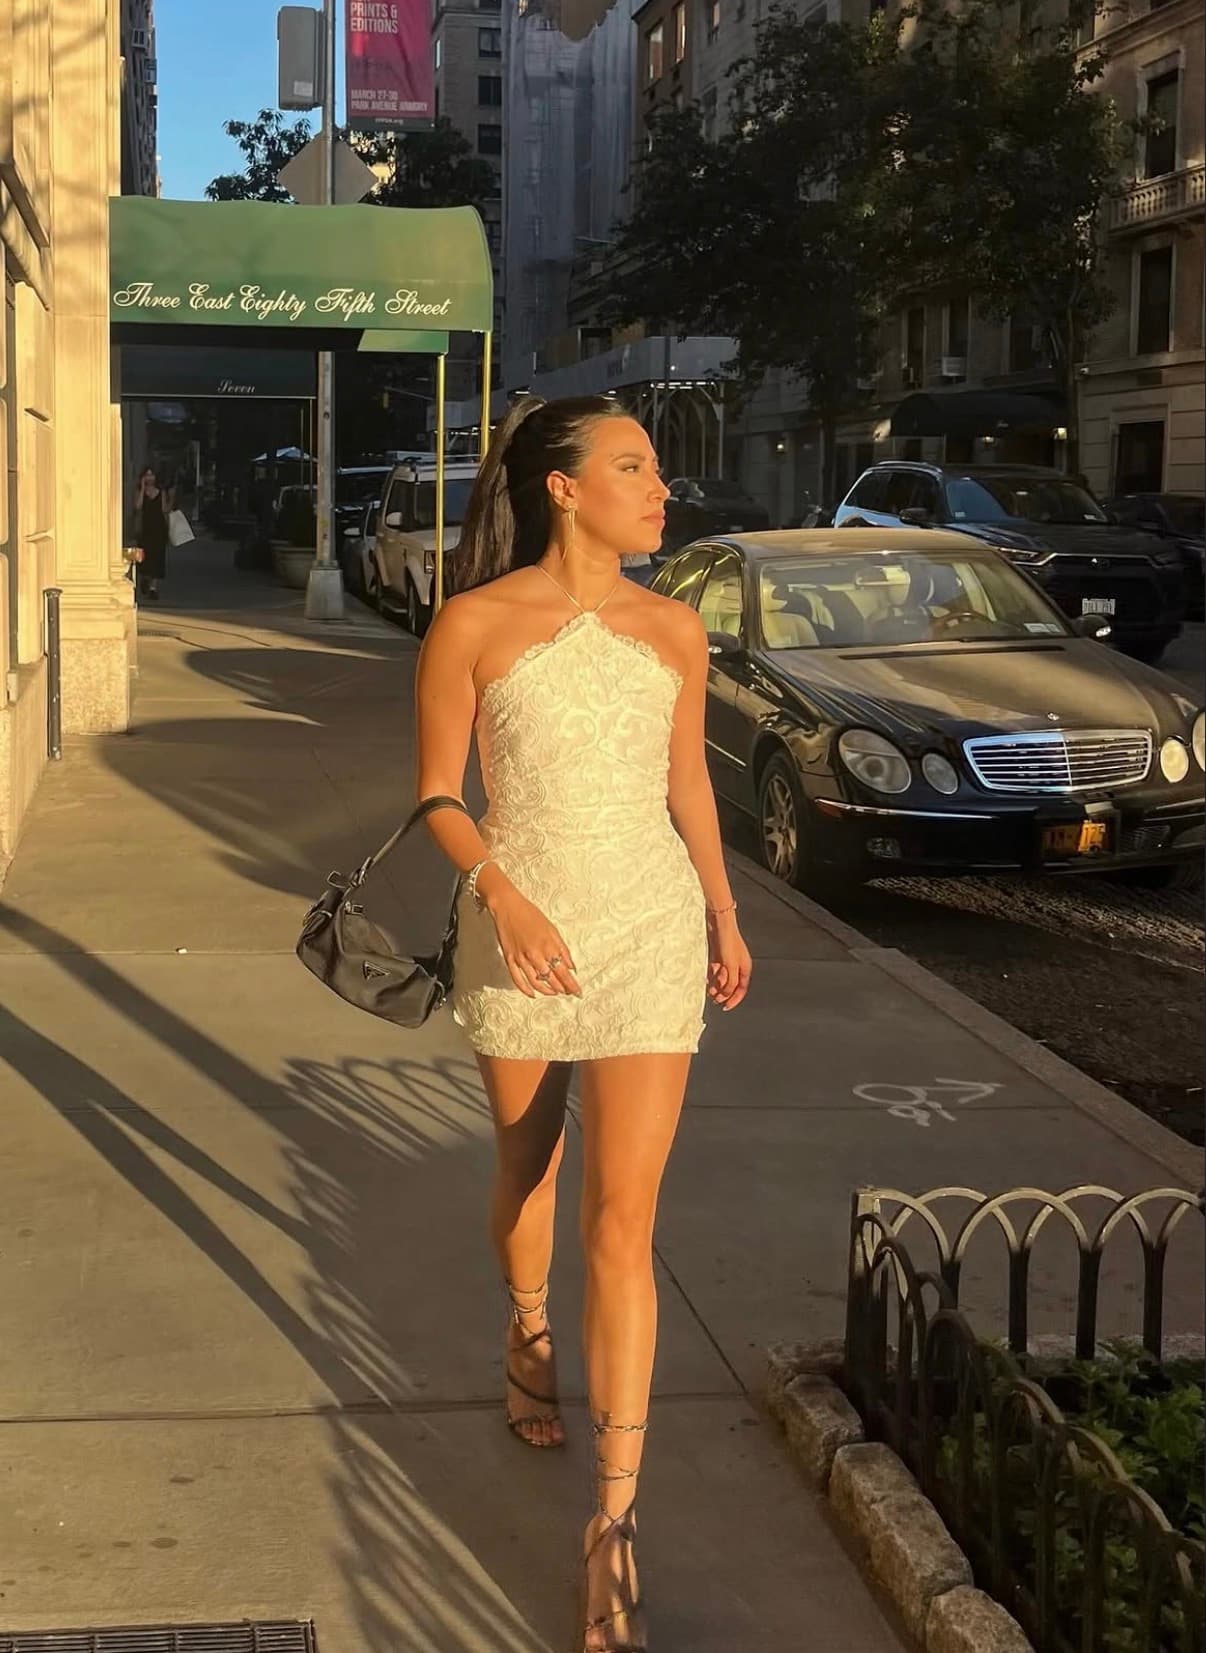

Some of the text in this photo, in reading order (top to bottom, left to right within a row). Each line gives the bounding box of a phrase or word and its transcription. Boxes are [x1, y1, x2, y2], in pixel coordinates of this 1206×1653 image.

[350, 2, 398, 19] PRINTS &
[350, 18, 398, 33] EDITIONS
[351, 89, 376, 100] MARCH
[351, 100, 369, 110] PARK
[370, 101, 398, 111] AVENUE
[113, 282, 452, 322] Three East Eighty Fifth Street
[217, 378, 256, 393] Seven
